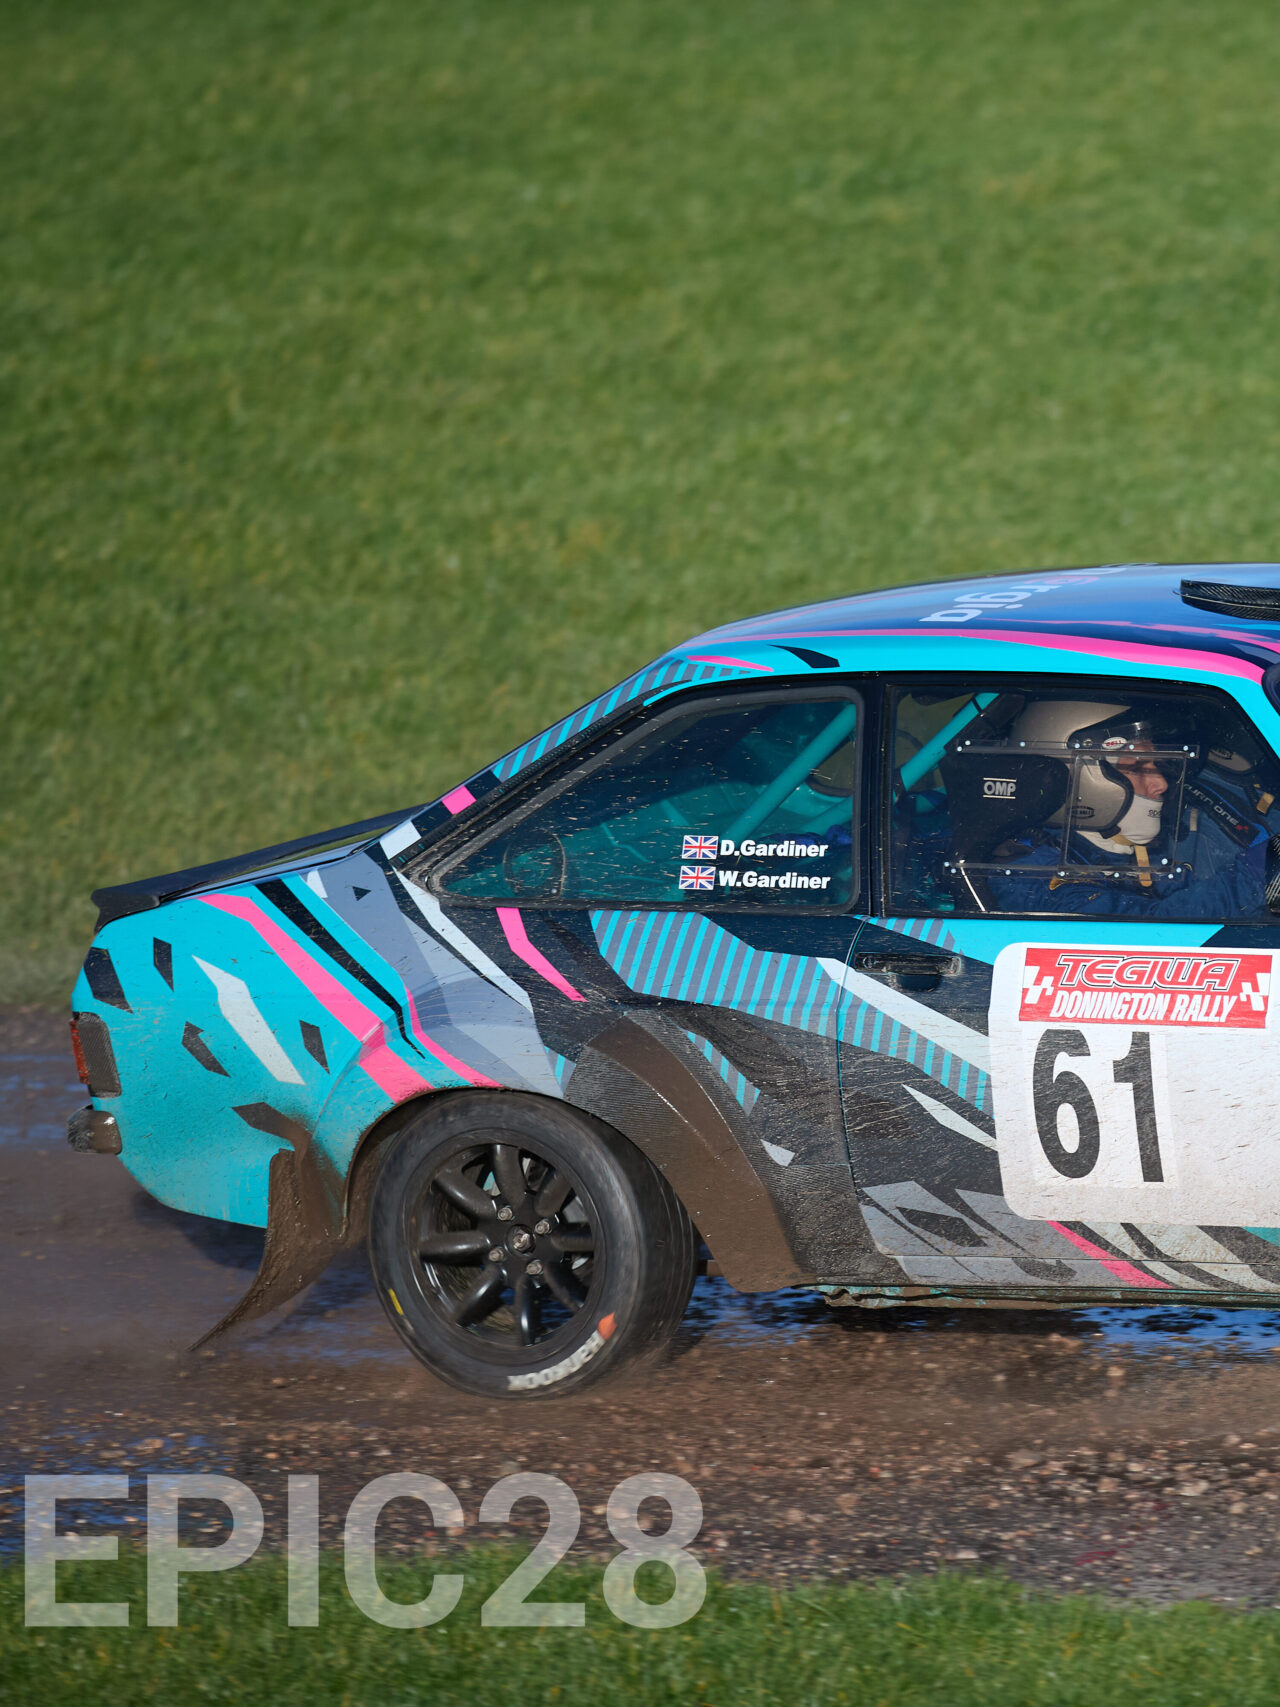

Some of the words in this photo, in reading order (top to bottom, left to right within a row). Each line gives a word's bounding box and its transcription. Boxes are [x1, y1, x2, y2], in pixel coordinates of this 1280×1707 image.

[983, 781, 1016, 796] OMP
[720, 839, 828, 857] D.Gardiner
[718, 870, 831, 889] W.Gardiner
[1057, 954, 1239, 991] TEGIWA
[1050, 990, 1172, 1021] DONINGTON
[1170, 993, 1238, 1022] RALLY
[1032, 1028, 1165, 1183] 61
